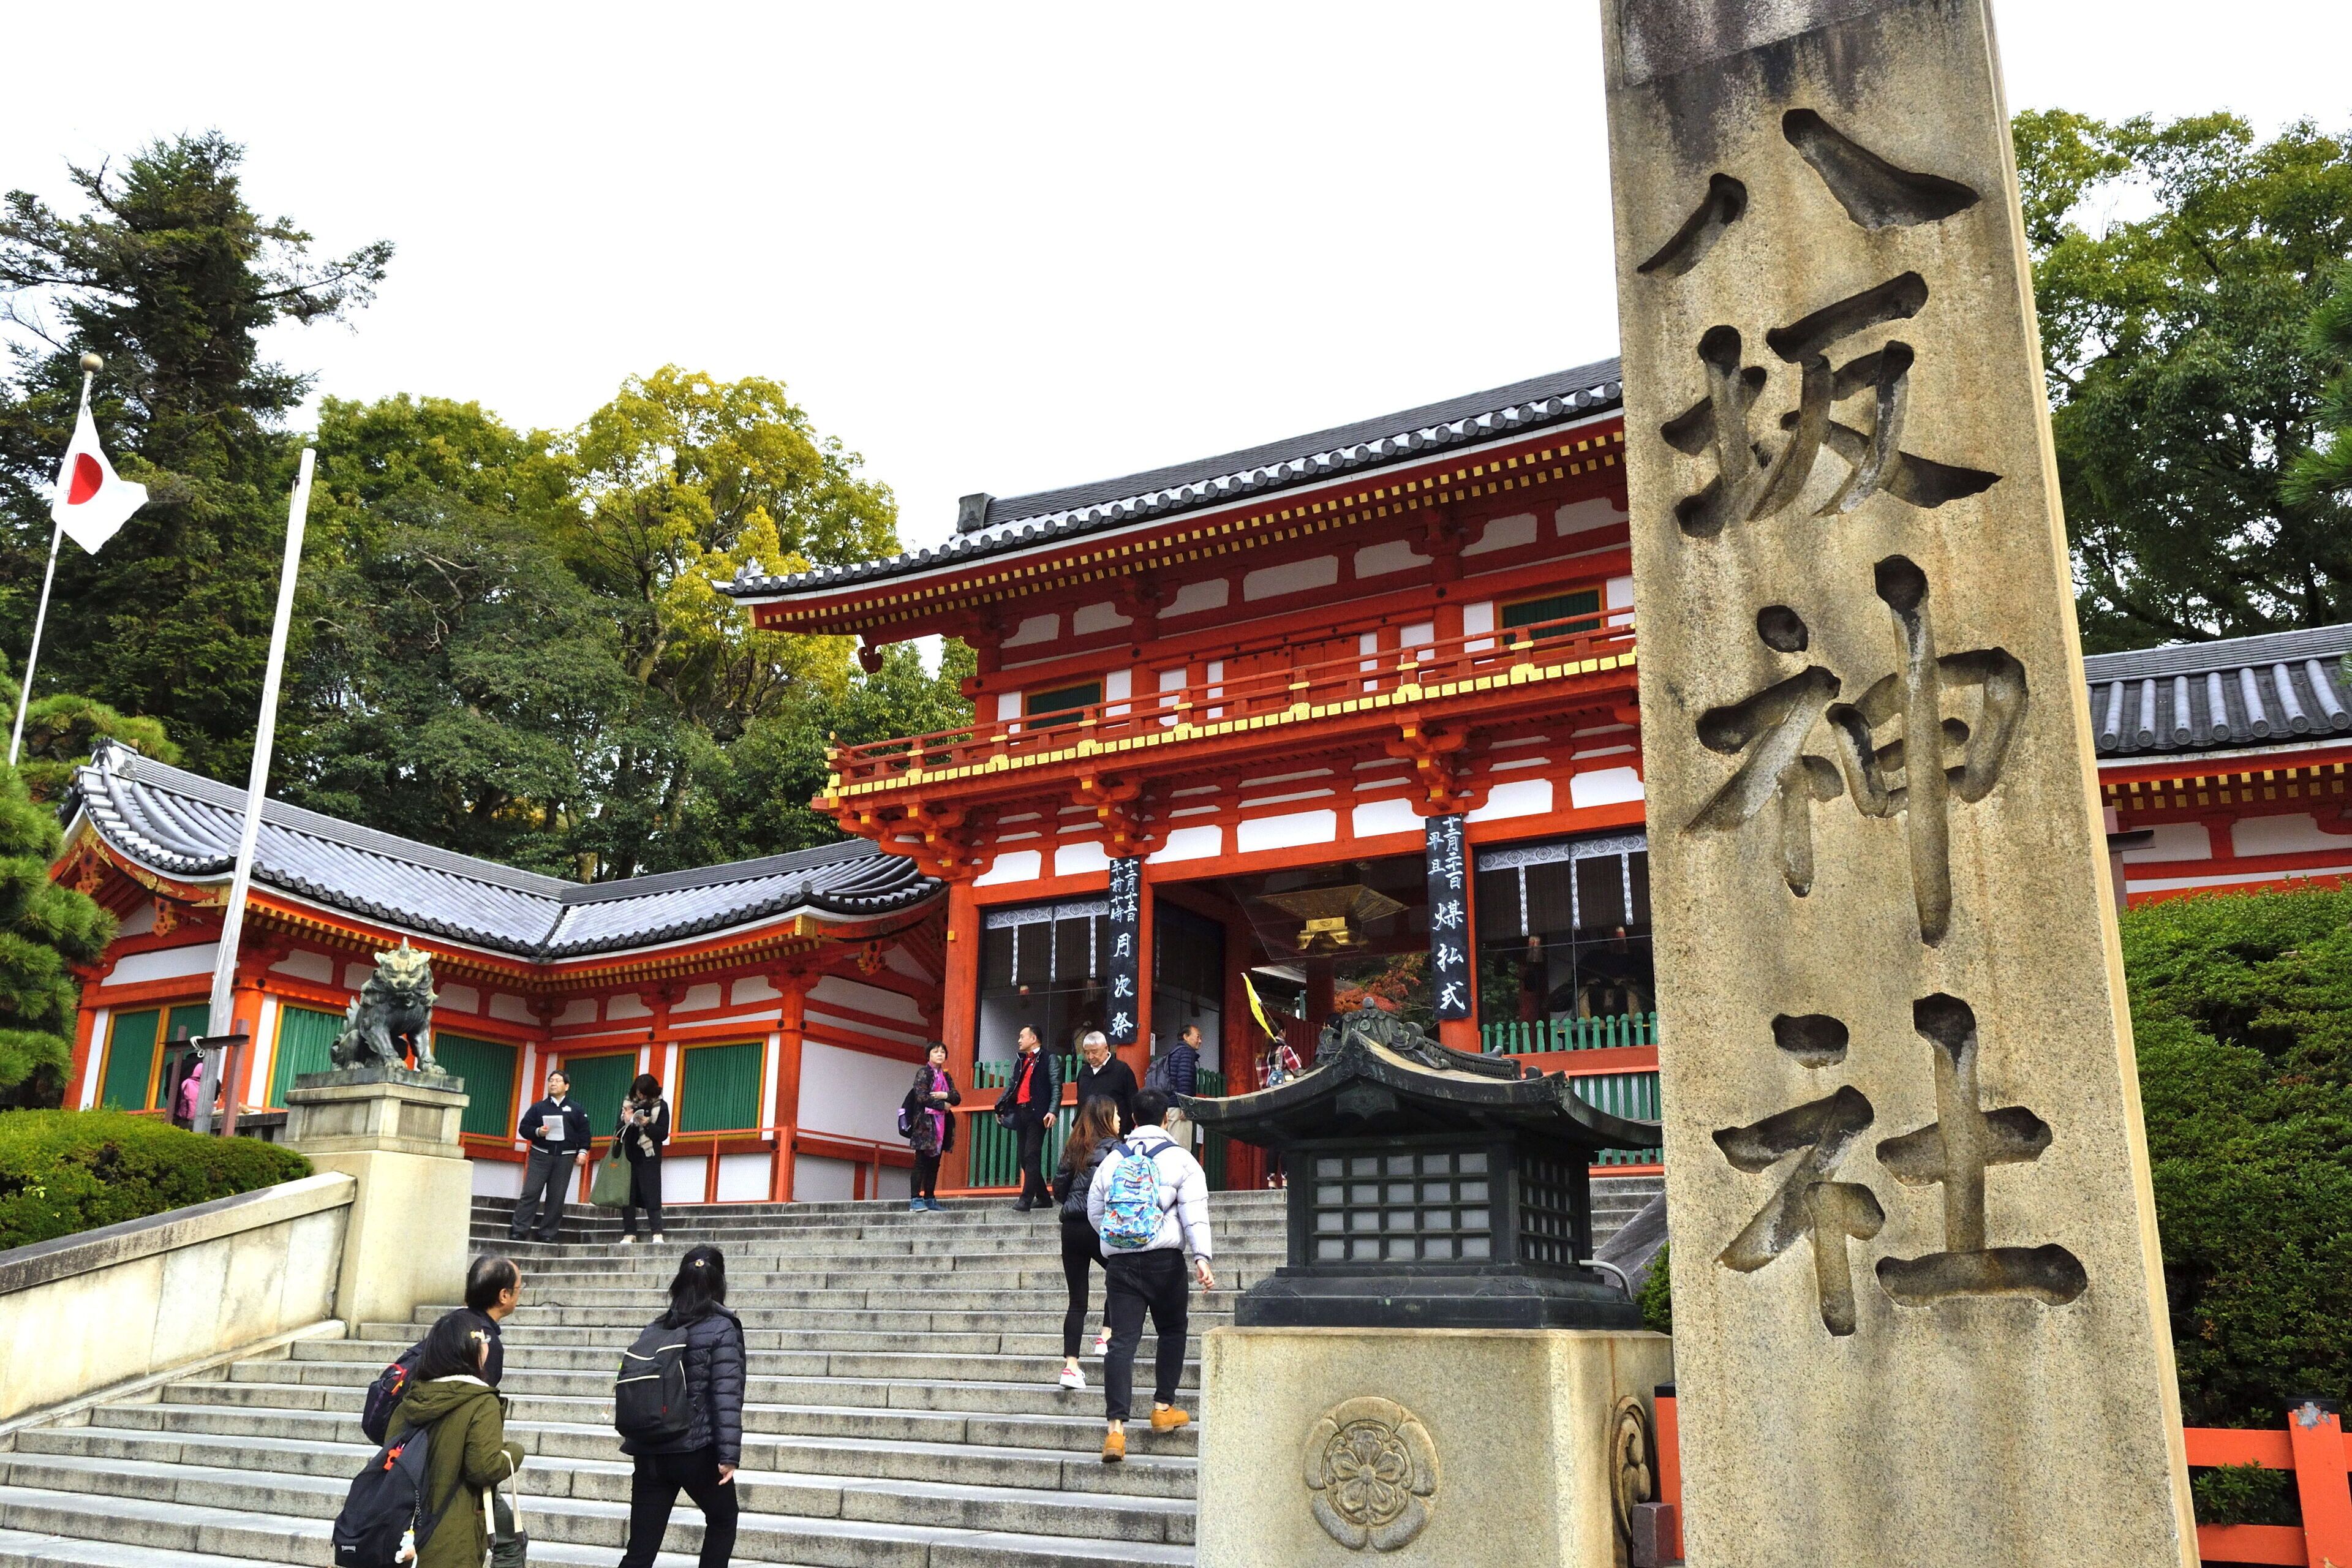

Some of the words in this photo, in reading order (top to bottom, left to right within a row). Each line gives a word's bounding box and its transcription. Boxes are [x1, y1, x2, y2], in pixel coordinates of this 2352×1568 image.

[1637, 108, 2089, 1338] 八坂神社
[1109, 860, 1125, 923] 午前十時
[1124, 859, 1139, 922] 十二月十五日
[1109, 932, 1134, 1038] 月次祭
[1432, 899, 1466, 1010] 煤払式
